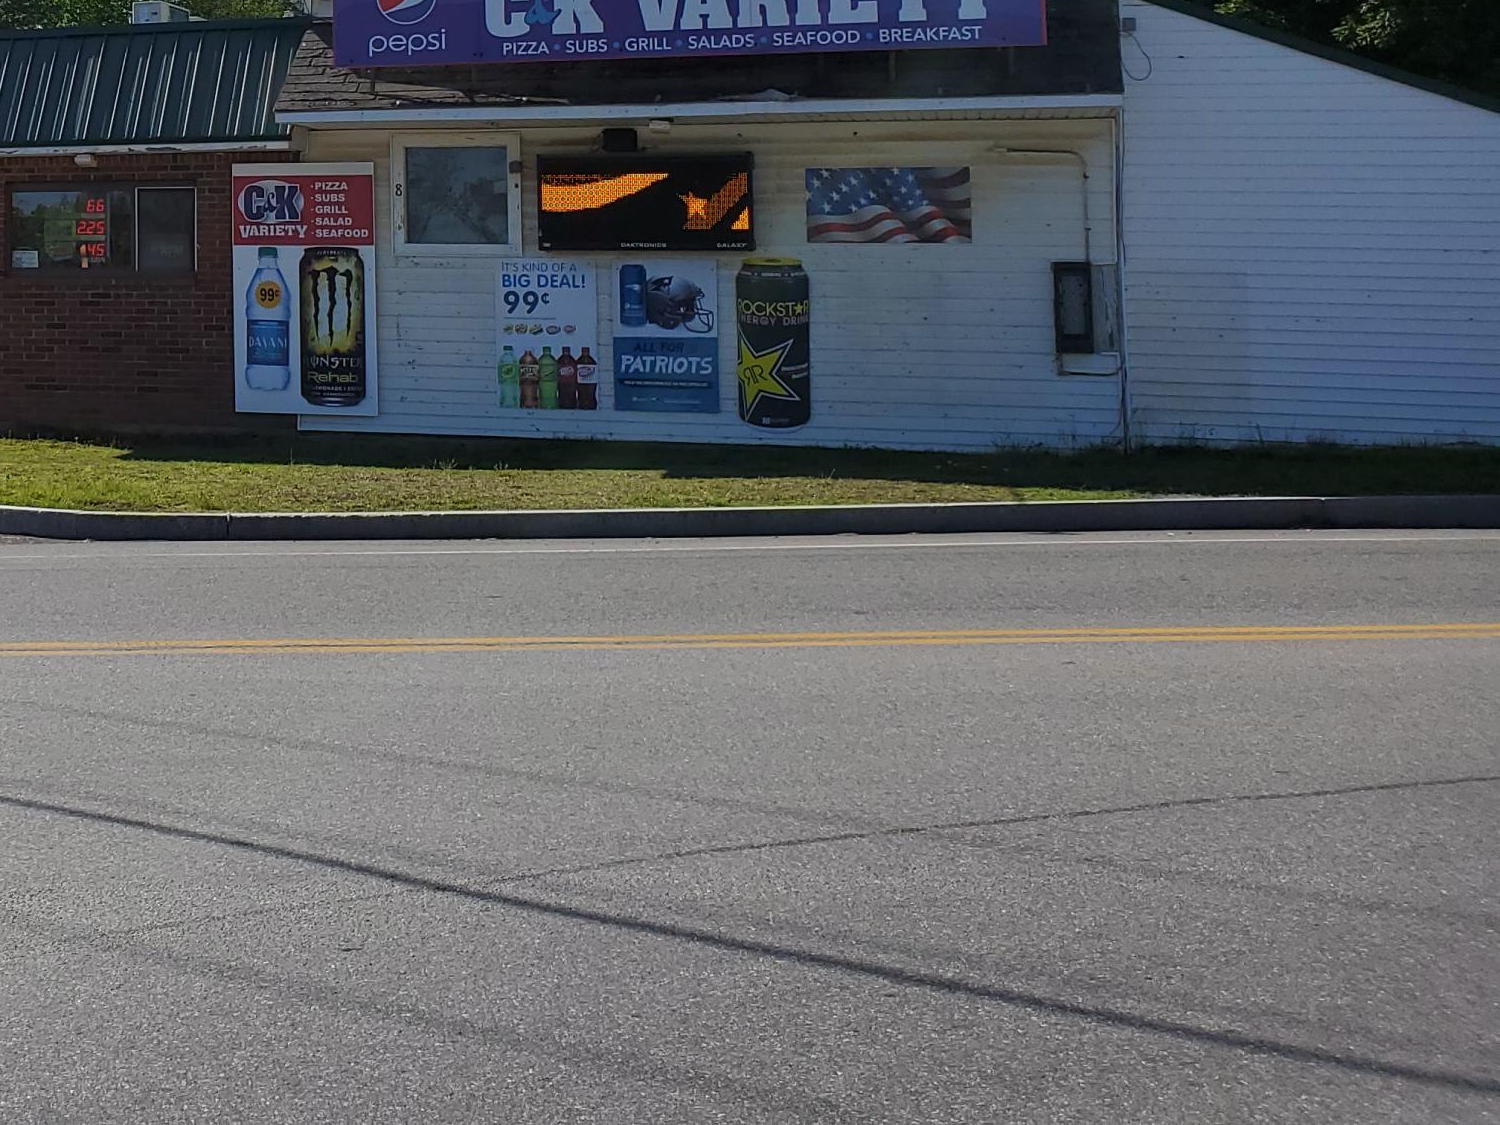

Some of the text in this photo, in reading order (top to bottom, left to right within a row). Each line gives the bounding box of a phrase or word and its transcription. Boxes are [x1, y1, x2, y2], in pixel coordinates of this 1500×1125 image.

[368, 28, 446, 58] pepsi
[503, 25, 983, 55] PIZZA SUBS GRILL SALADS SEAFOOD BREAKFAST
[314, 181, 349, 191] PIZZA
[243, 184, 300, 221] C&K
[314, 193, 346, 203] SUBS
[314, 205, 349, 215] GRILL
[314, 216, 353, 227] SALAD
[239, 225, 308, 238] VARIETY
[314, 228, 369, 238] SEAFOOD
[522, 262, 548, 274] KIND
[551, 262, 566, 272] OF
[569, 262, 577, 272] A
[502, 274, 586, 288] BIG DEAL!
[633, 342, 684, 353] ALL FOR
[620, 355, 713, 374] PATRIOTS
